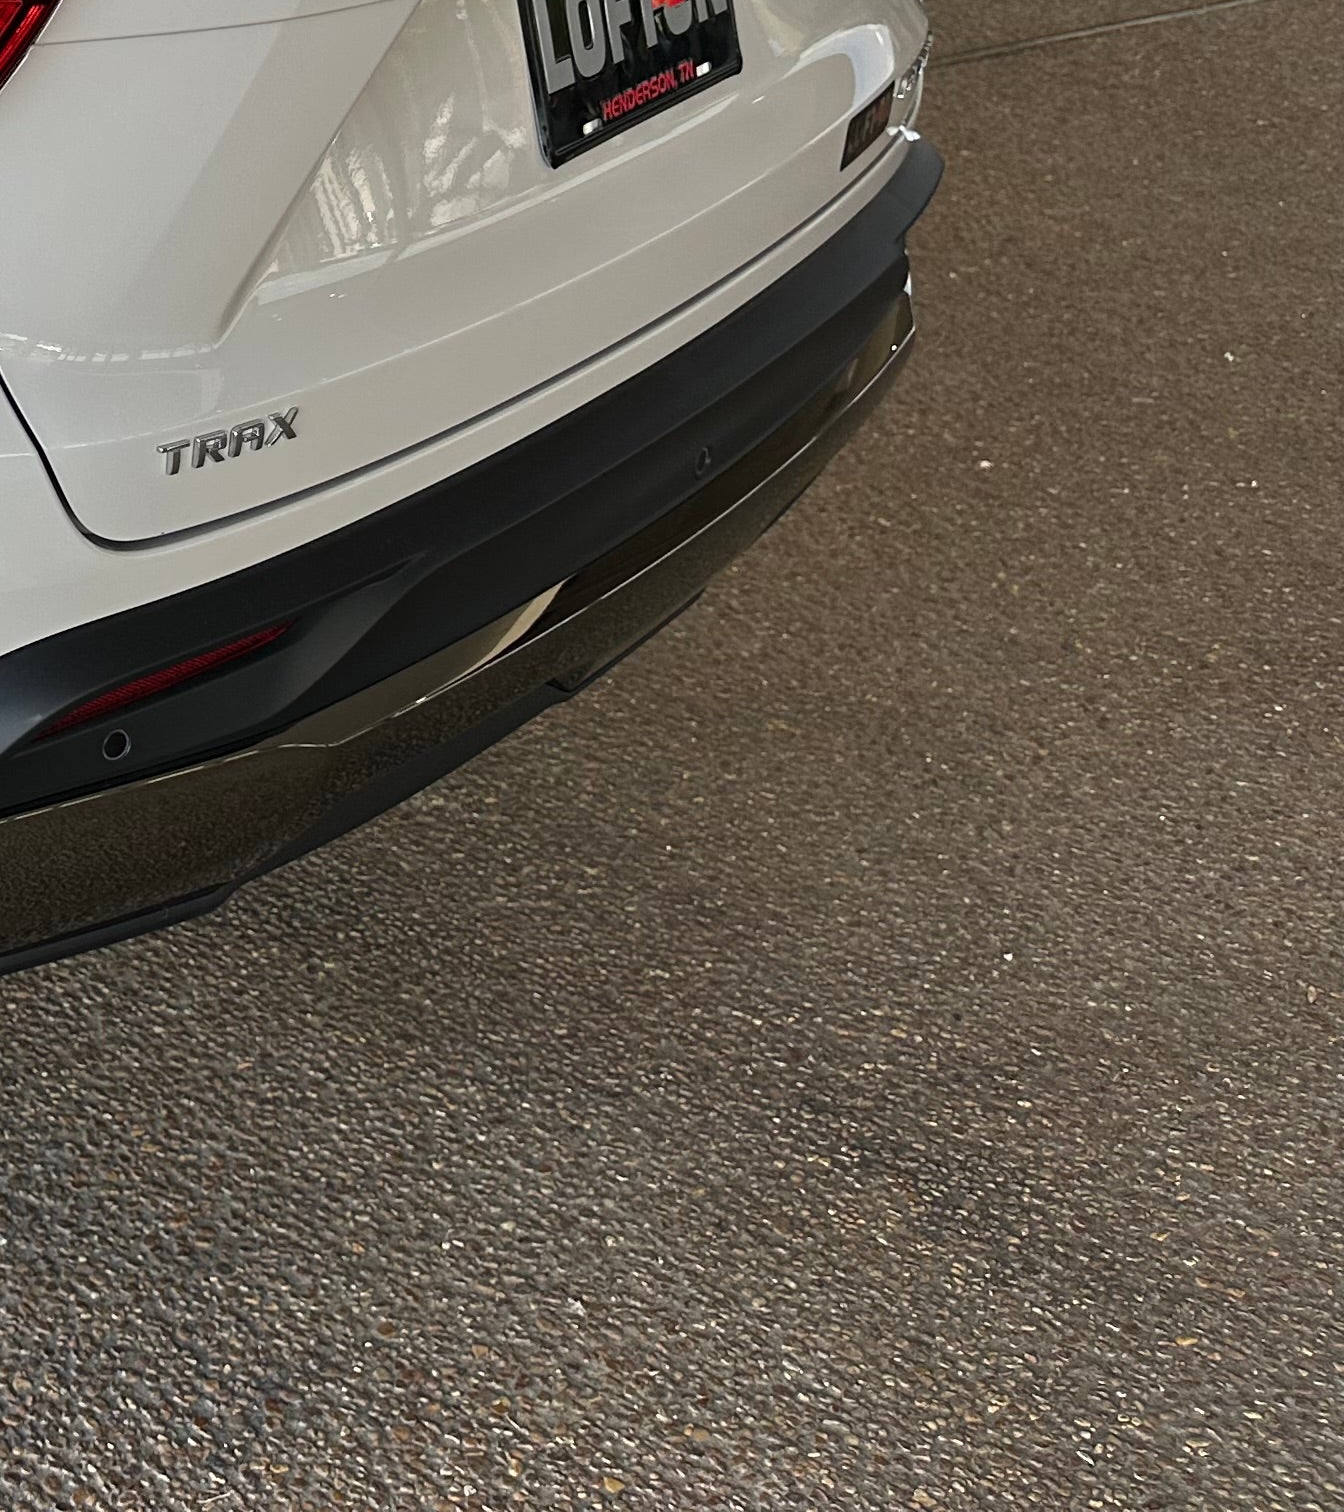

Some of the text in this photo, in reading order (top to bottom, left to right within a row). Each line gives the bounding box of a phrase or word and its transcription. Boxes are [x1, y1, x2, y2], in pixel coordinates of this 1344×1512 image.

[601, 57, 695, 121] HENDERSON, TN
[156, 406, 300, 476] TRAX
